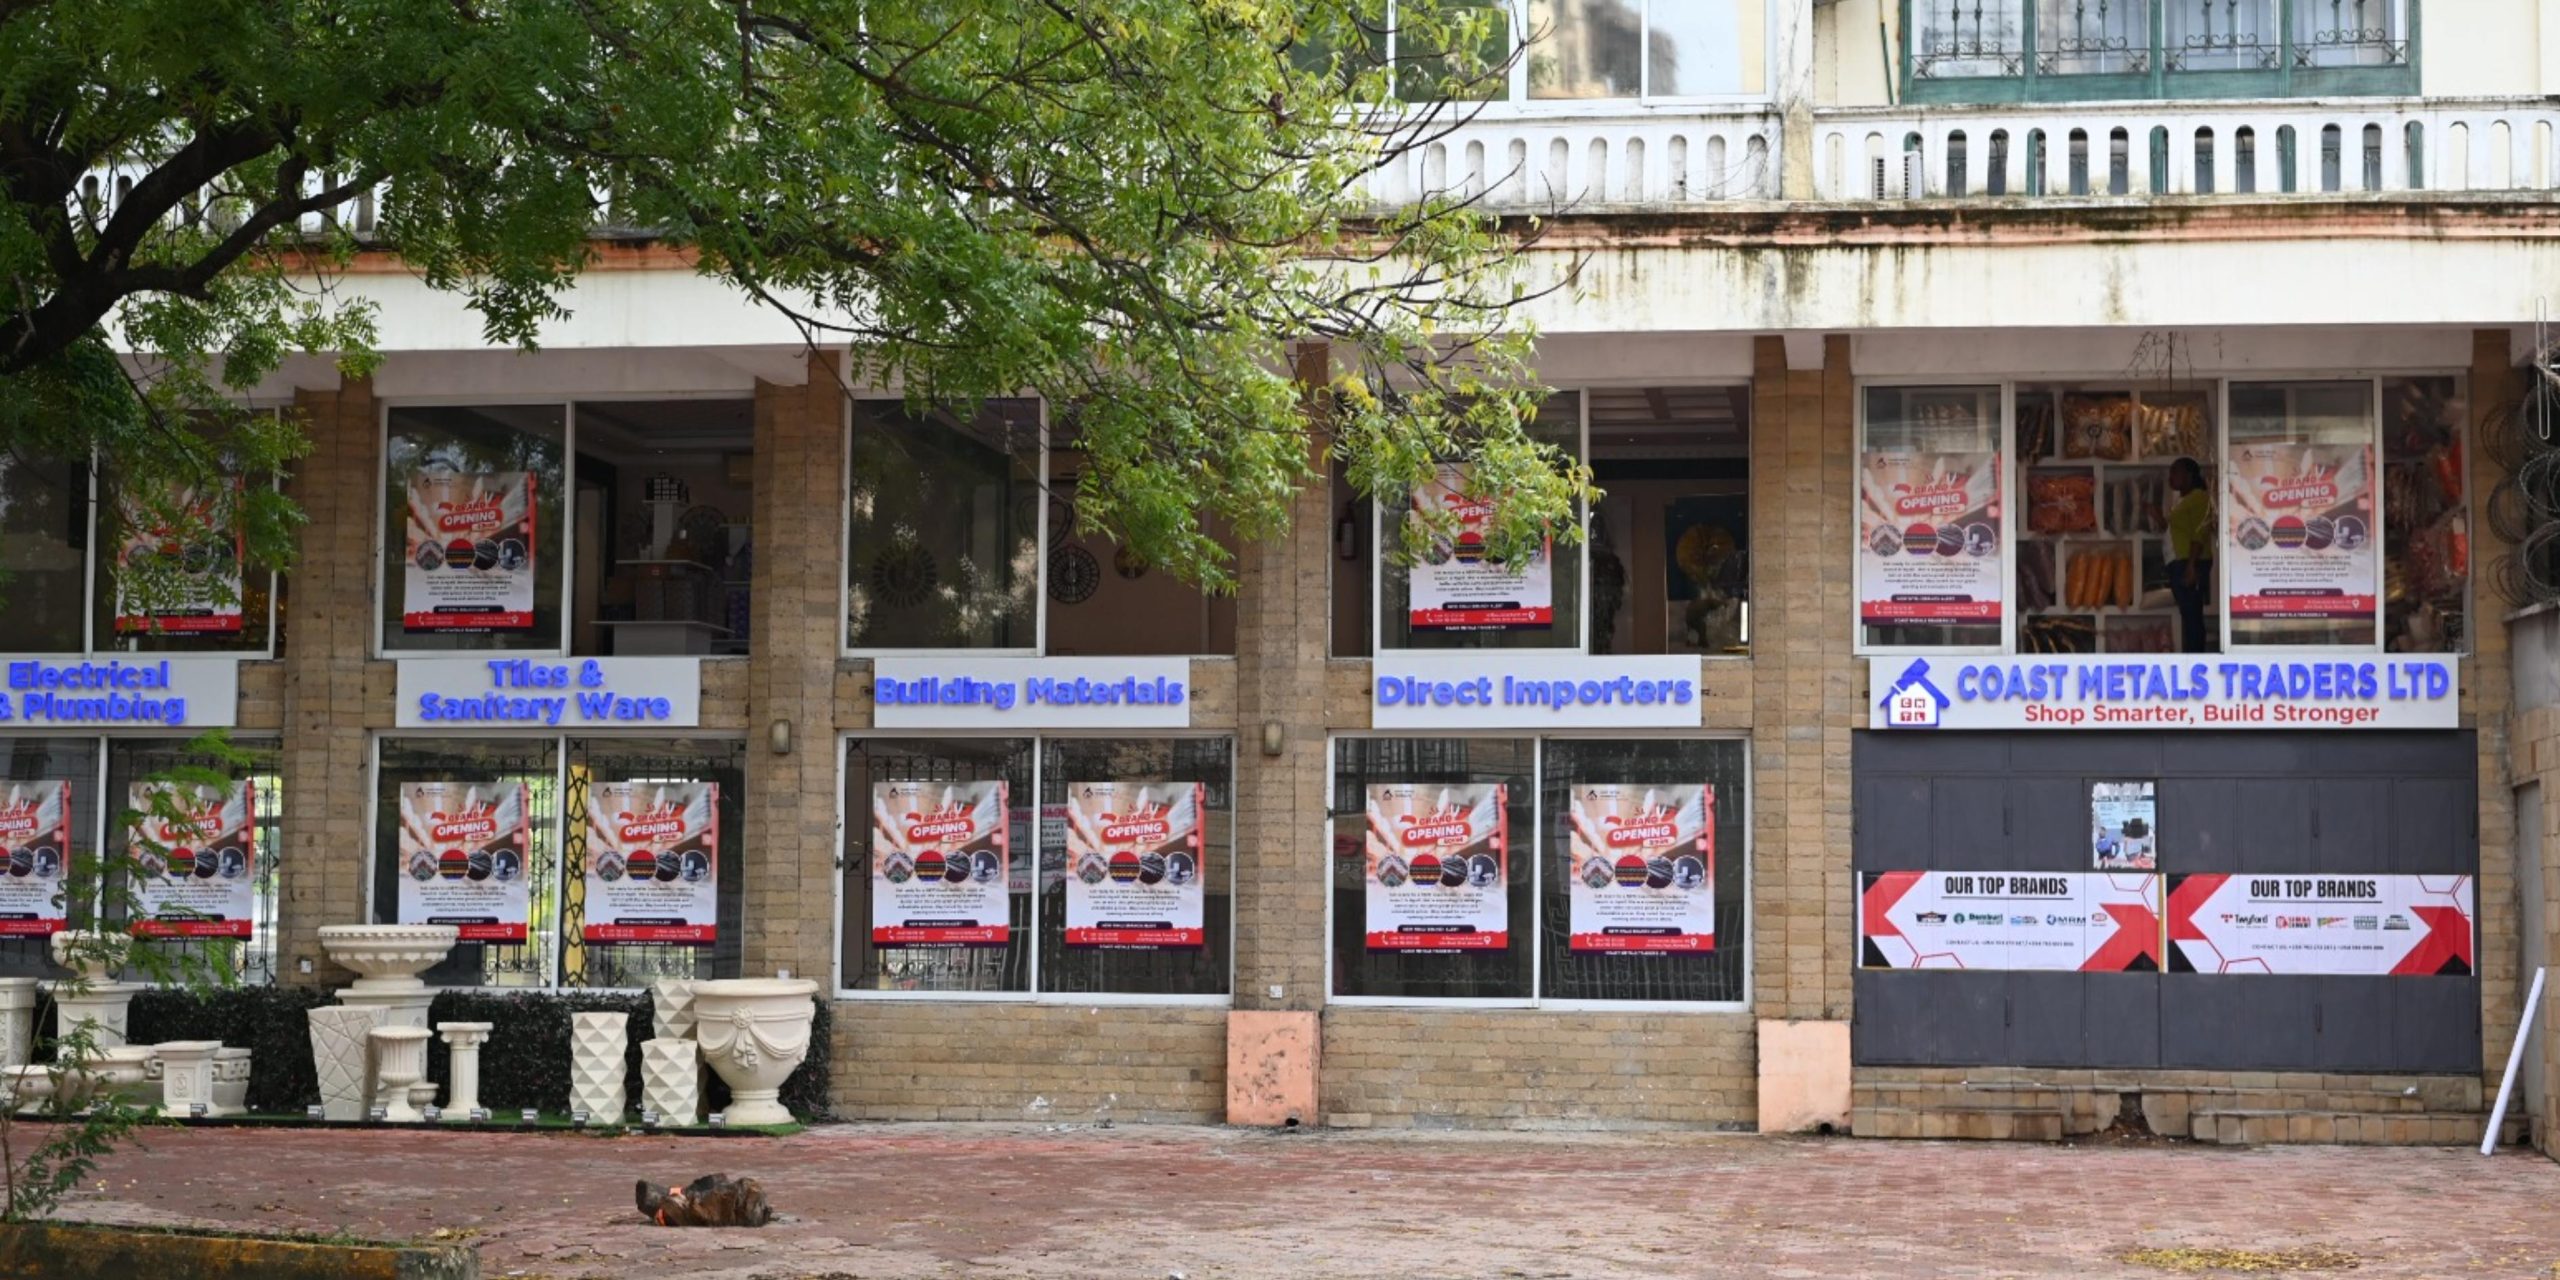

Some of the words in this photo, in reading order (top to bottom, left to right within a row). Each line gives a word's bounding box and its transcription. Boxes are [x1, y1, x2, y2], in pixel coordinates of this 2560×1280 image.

[1914, 484, 1949, 494] GRAND
[2281, 476, 2317, 487] GRAND
[1901, 493, 1961, 509] OPENING
[2268, 486, 2330, 503] OPENING
[444, 511, 497, 526] OPENING
[10, 660, 169, 688] Electrical
[487, 660, 570, 687] Tiles
[577, 659, 604, 687] &
[1957, 664, 2070, 703] COAST
[2078, 663, 2210, 701] METALS
[2218, 661, 2379, 700] TRADERS
[2386, 661, 2451, 699] LTD
[875, 675, 1018, 710] Building
[1027, 675, 1187, 706] Materials
[1377, 674, 1495, 706] Direct
[1503, 673, 1694, 710] Importers
[23, 692, 186, 725] Plumbing
[420, 692, 567, 725] Sanitary
[577, 692, 671, 719] Ware
[2024, 704, 2085, 725] Shop
[2093, 704, 2195, 724] Smarter,
[2204, 703, 2265, 722] Build
[2274, 703, 2380, 725] Stronger
[1418, 814, 1453, 825] GRAND
[1624, 815, 1659, 826] GRAND
[437, 820, 490, 836] OPENING
[624, 820, 679, 836] OPENING
[912, 822, 969, 839] OPENING
[1107, 822, 1162, 838] OPENING
[1407, 825, 1464, 840] OPENING
[1613, 825, 1670, 841] OPENING
[1945, 877, 1972, 894] OUR
[1979, 877, 2005, 894] TOP
[2010, 877, 2067, 895] BRANDS
[2251, 879, 2280, 897] OUR
[2286, 879, 2312, 897] TOP
[2318, 880, 2377, 898] BRANDS
[2235, 914, 2269, 925] Twyford
